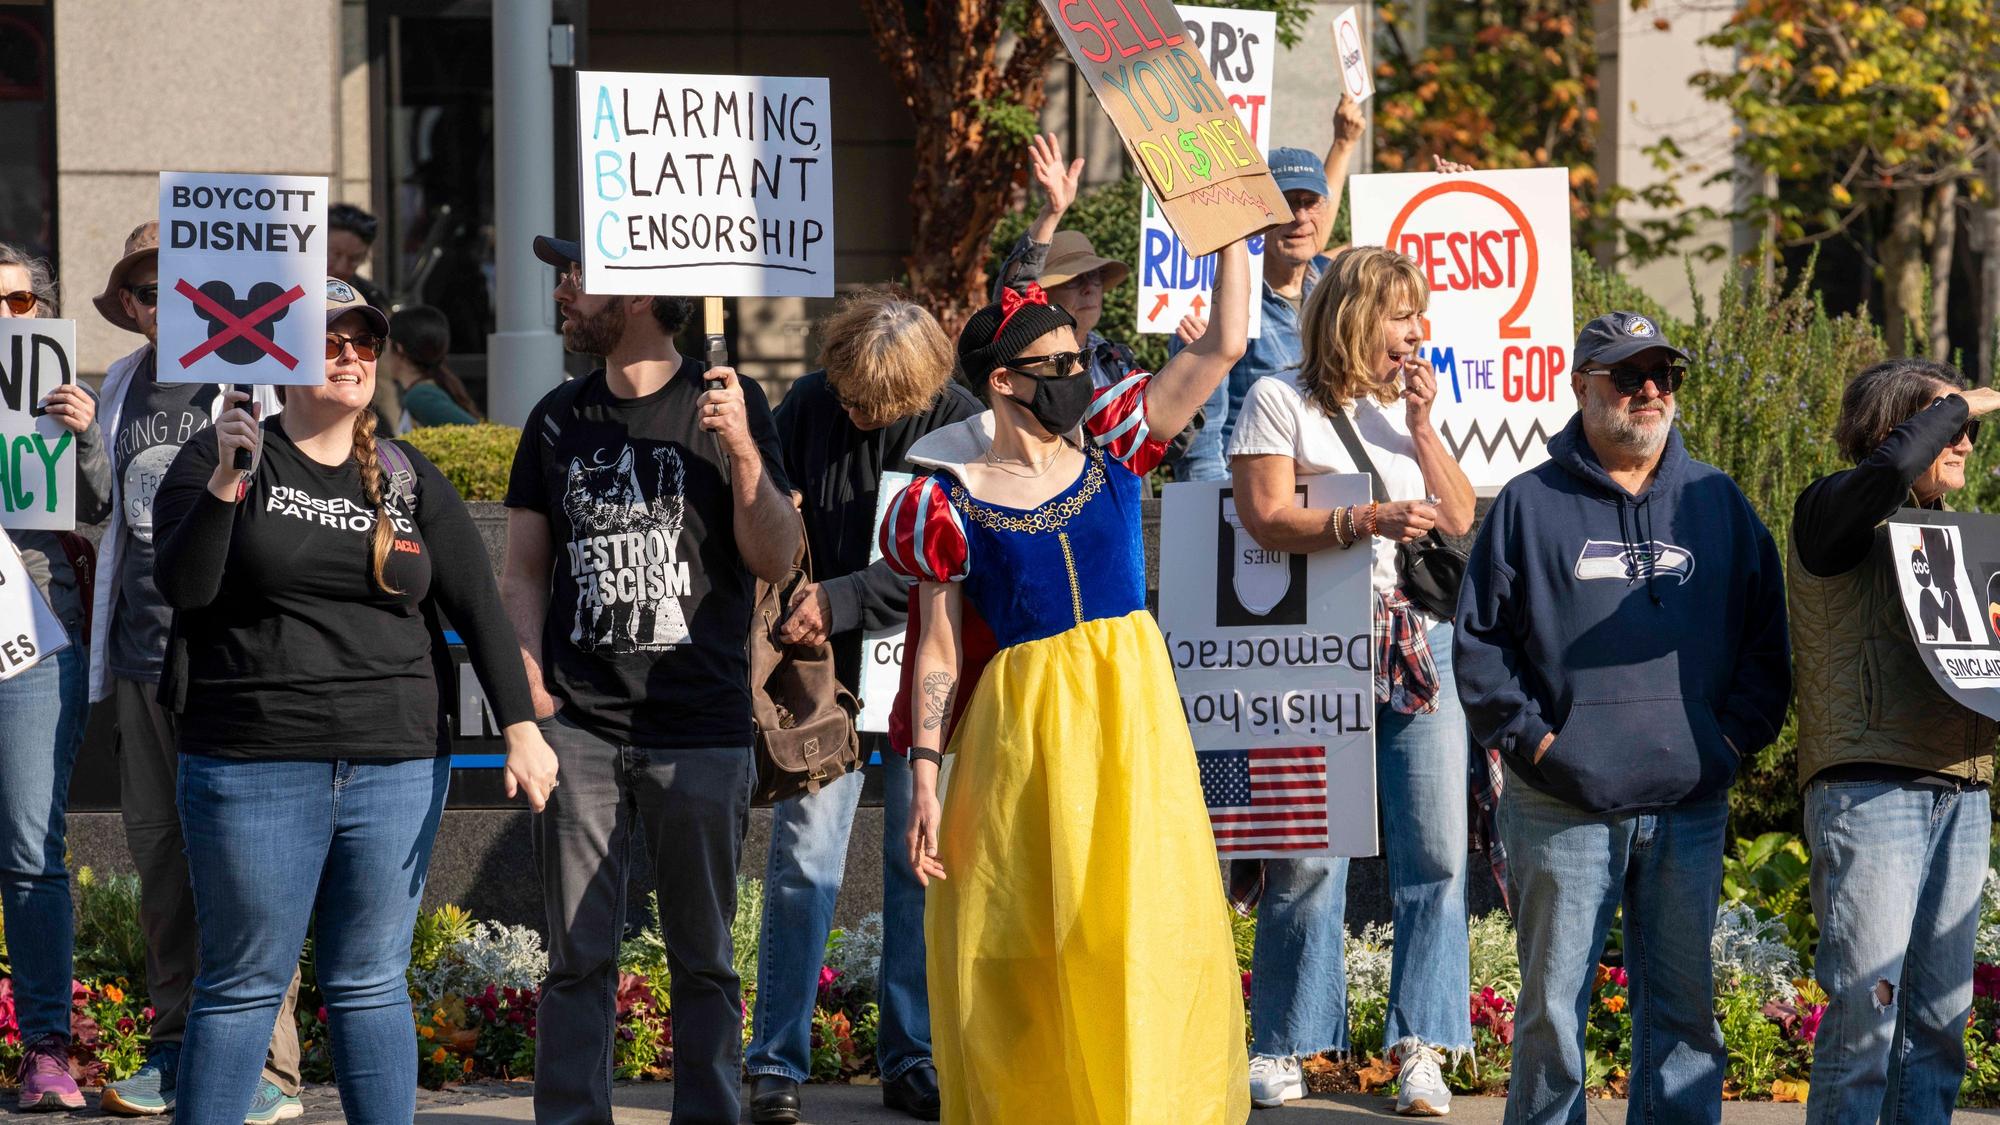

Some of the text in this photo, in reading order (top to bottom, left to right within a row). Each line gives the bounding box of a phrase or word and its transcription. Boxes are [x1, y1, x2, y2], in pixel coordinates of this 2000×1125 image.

[1058, 0, 1185, 63] SELL
[1102, 47, 1225, 132] YOUR
[593, 85, 821, 151] ALARMING,
[595, 149, 819, 202] BLATANT
[1138, 116, 1260, 194] DI$NEY
[172, 185, 316, 212] BOYCOTT
[170, 219, 317, 254] DISNEY
[596, 209, 823, 261] CENSORSHIP
[1400, 229, 1521, 292] RESIST
[1462, 359, 1495, 389] THE
[1502, 345, 1565, 402] GOP
[394, 540, 421, 555] ACLU
[566, 529, 681, 577] DESTROY
[1243, 549, 1281, 565] DIES
[1912, 559, 1930, 575] abc
[575, 561, 692, 610] FASCISM
